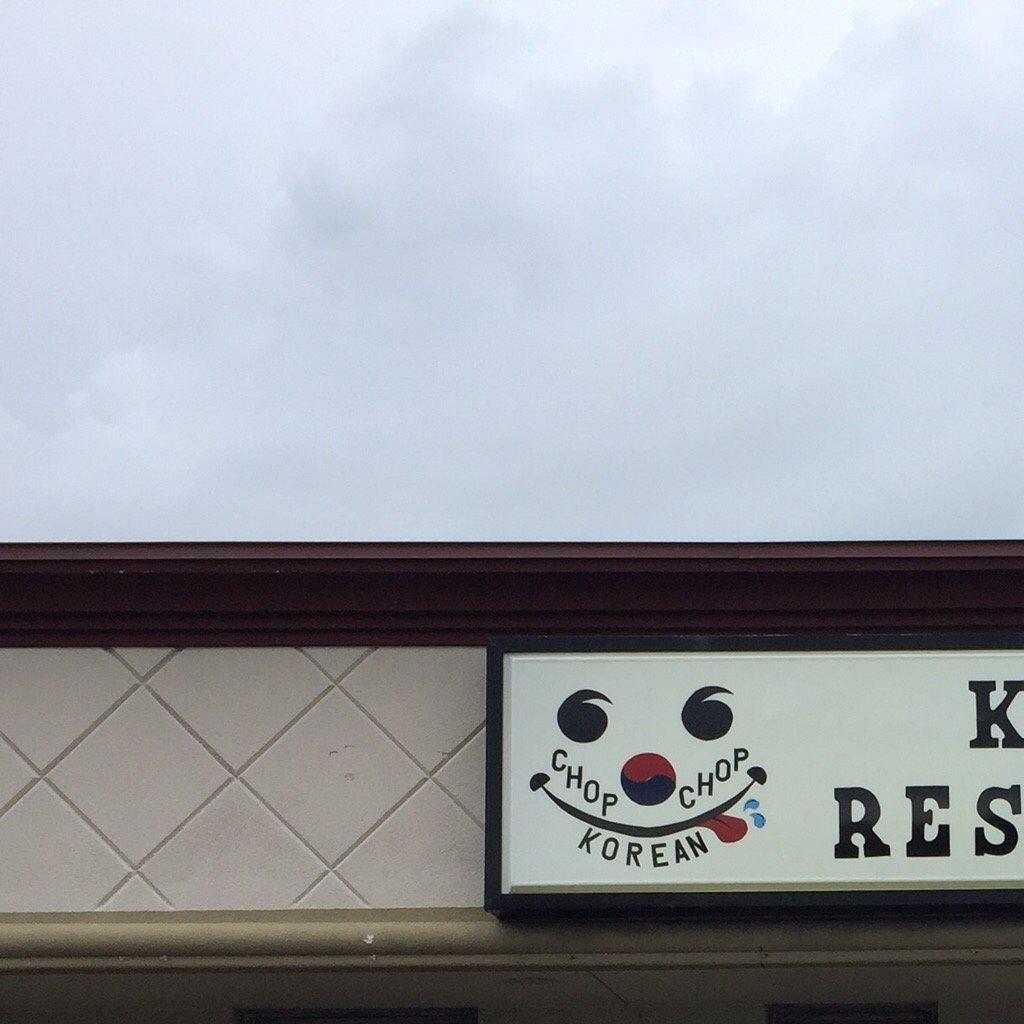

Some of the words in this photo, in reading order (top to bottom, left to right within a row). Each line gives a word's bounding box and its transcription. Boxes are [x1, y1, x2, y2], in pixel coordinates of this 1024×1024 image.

[551, 748, 619, 817] CHOP
[678, 747, 749, 810] CHOP
[577, 828, 709, 868] KOREAN
